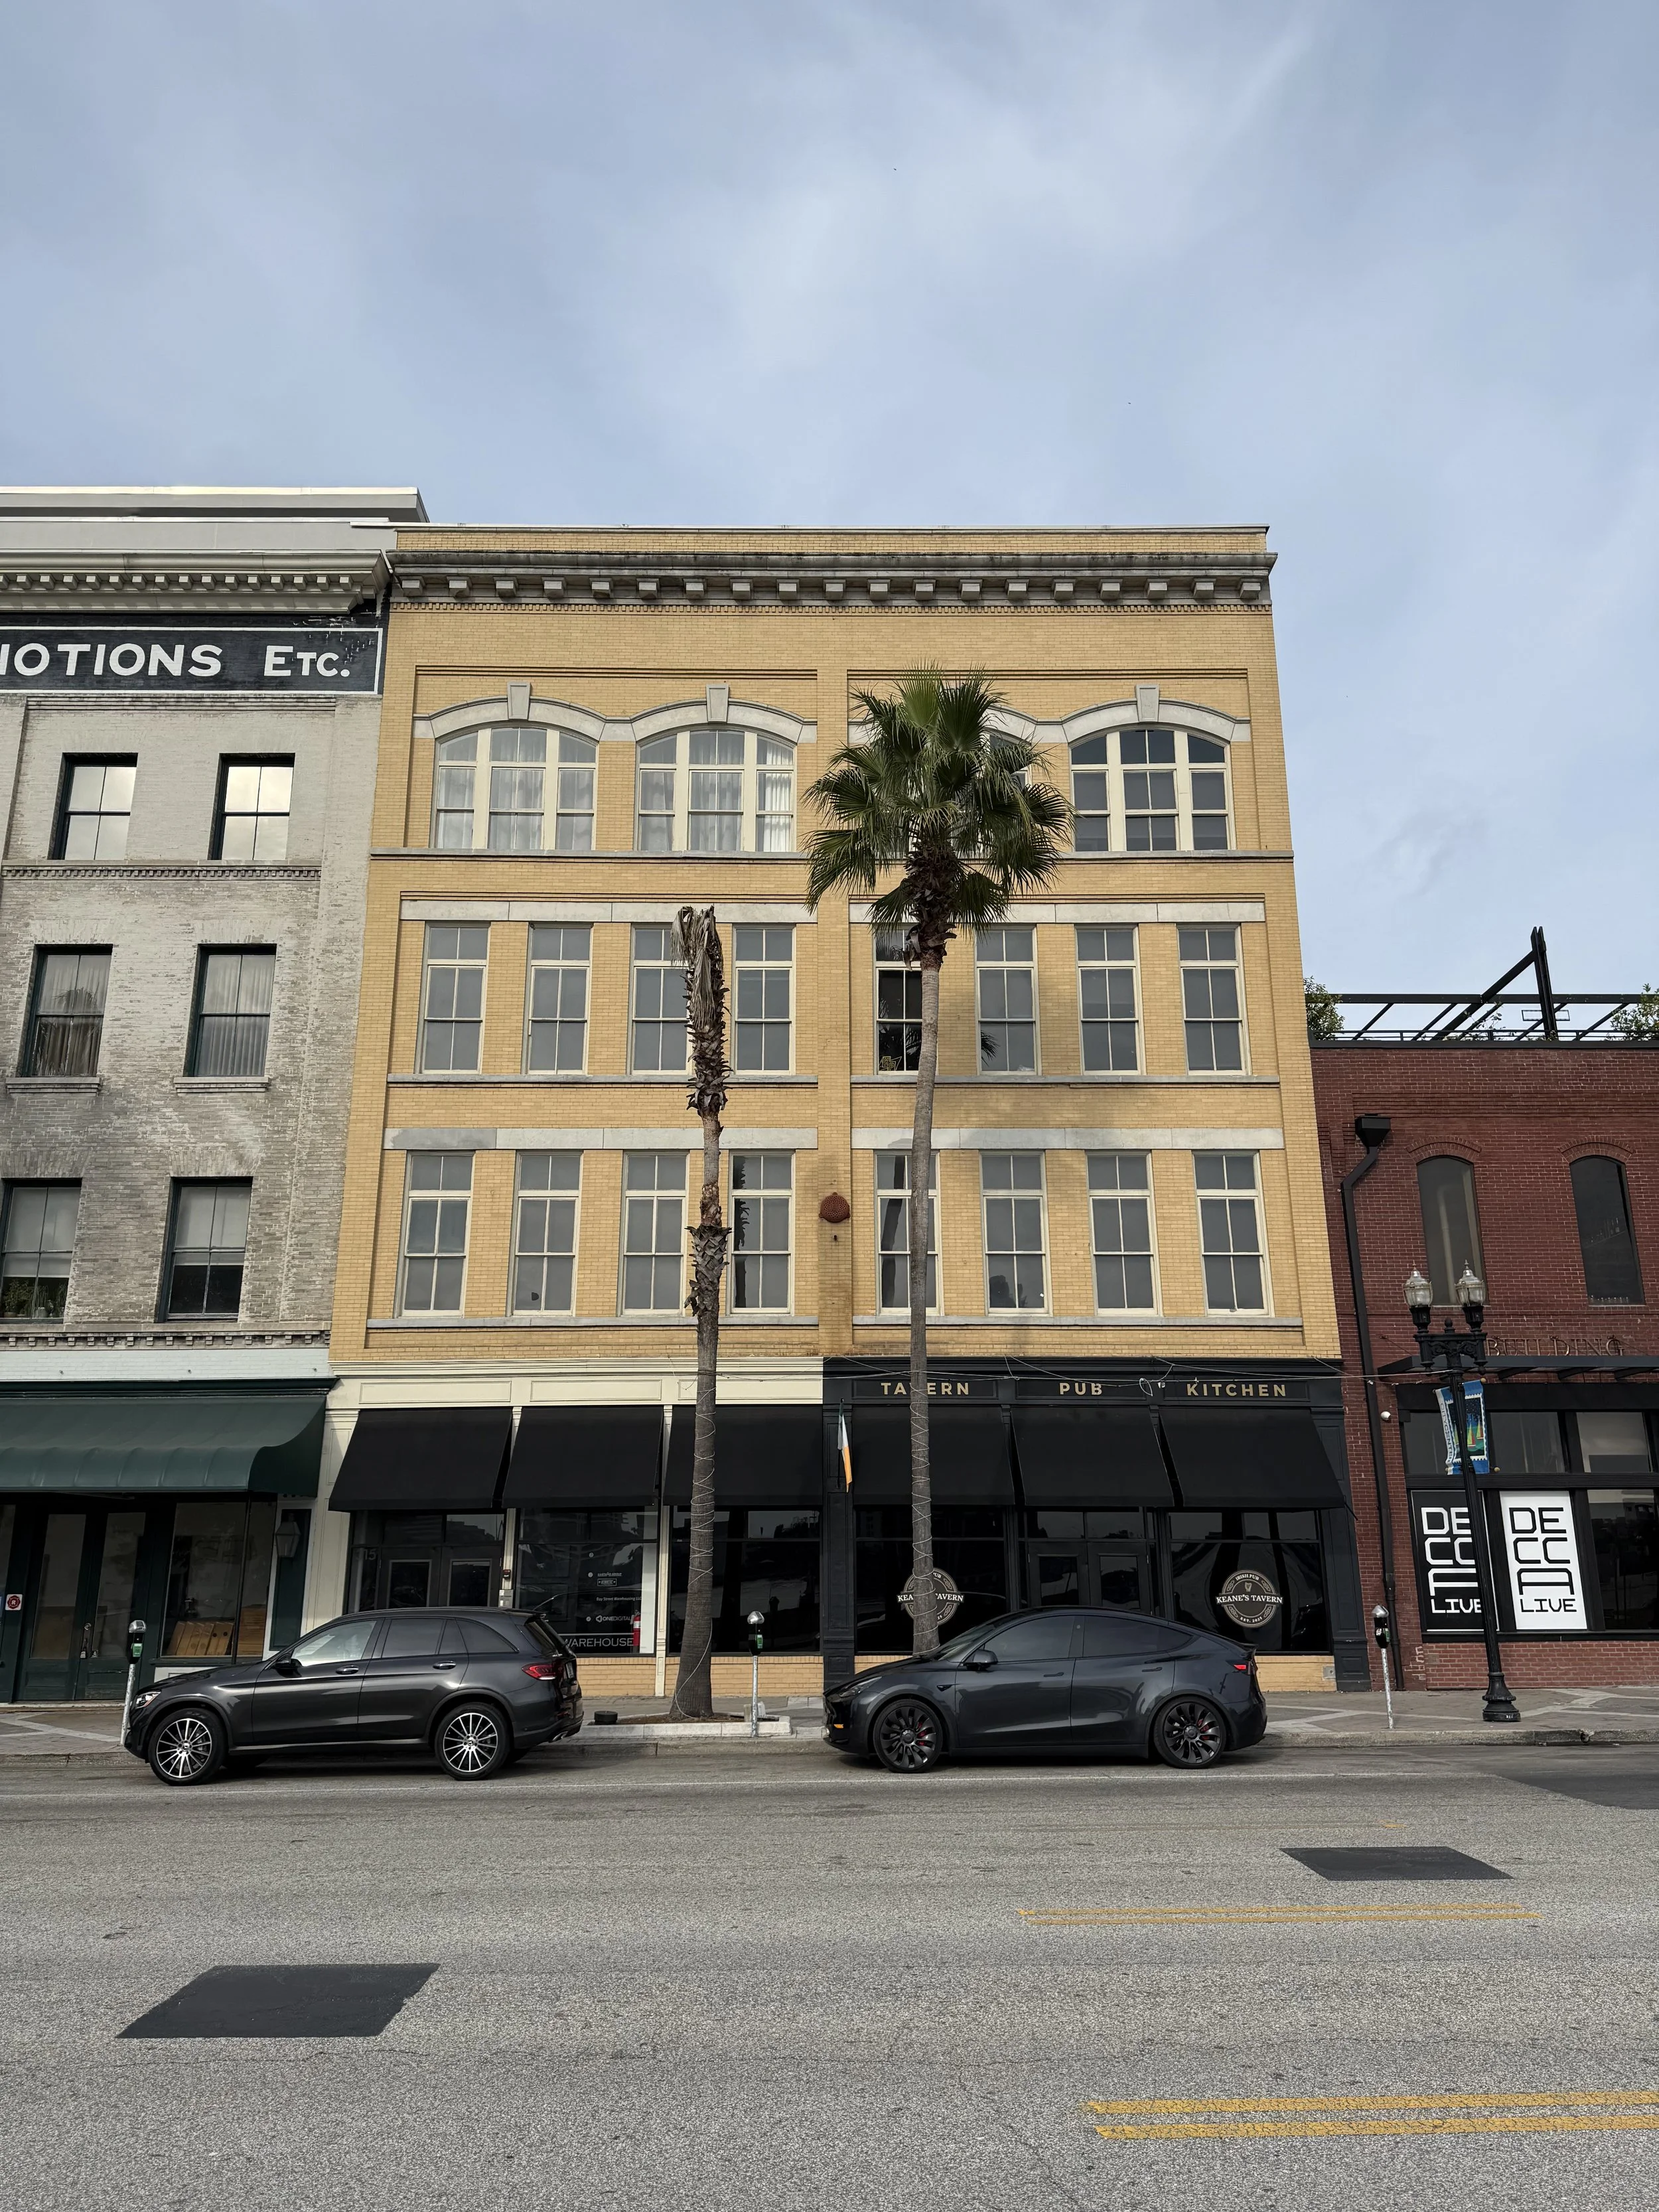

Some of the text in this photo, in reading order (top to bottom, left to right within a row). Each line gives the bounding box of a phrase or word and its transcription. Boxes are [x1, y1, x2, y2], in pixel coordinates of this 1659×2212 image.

[1486, 1337, 1625, 1356] BUILDING
[881, 1382, 969, 1395] TAERN
[1059, 1382, 1102, 1396] PUB
[1187, 1383, 1286, 1396] KITCHEN
[1421, 1507, 1471, 1534] DE
[1509, 1507, 1567, 1534] DE
[1513, 1537, 1571, 1564] CC
[1516, 1568, 1575, 1595] A
[935, 1593, 964, 1601] AVERN
[1216, 1594, 1283, 1603] KEANE'S TAVERN
[1431, 1599, 1482, 1613] LIVE
[1520, 1599, 1577, 1612] LIVE
